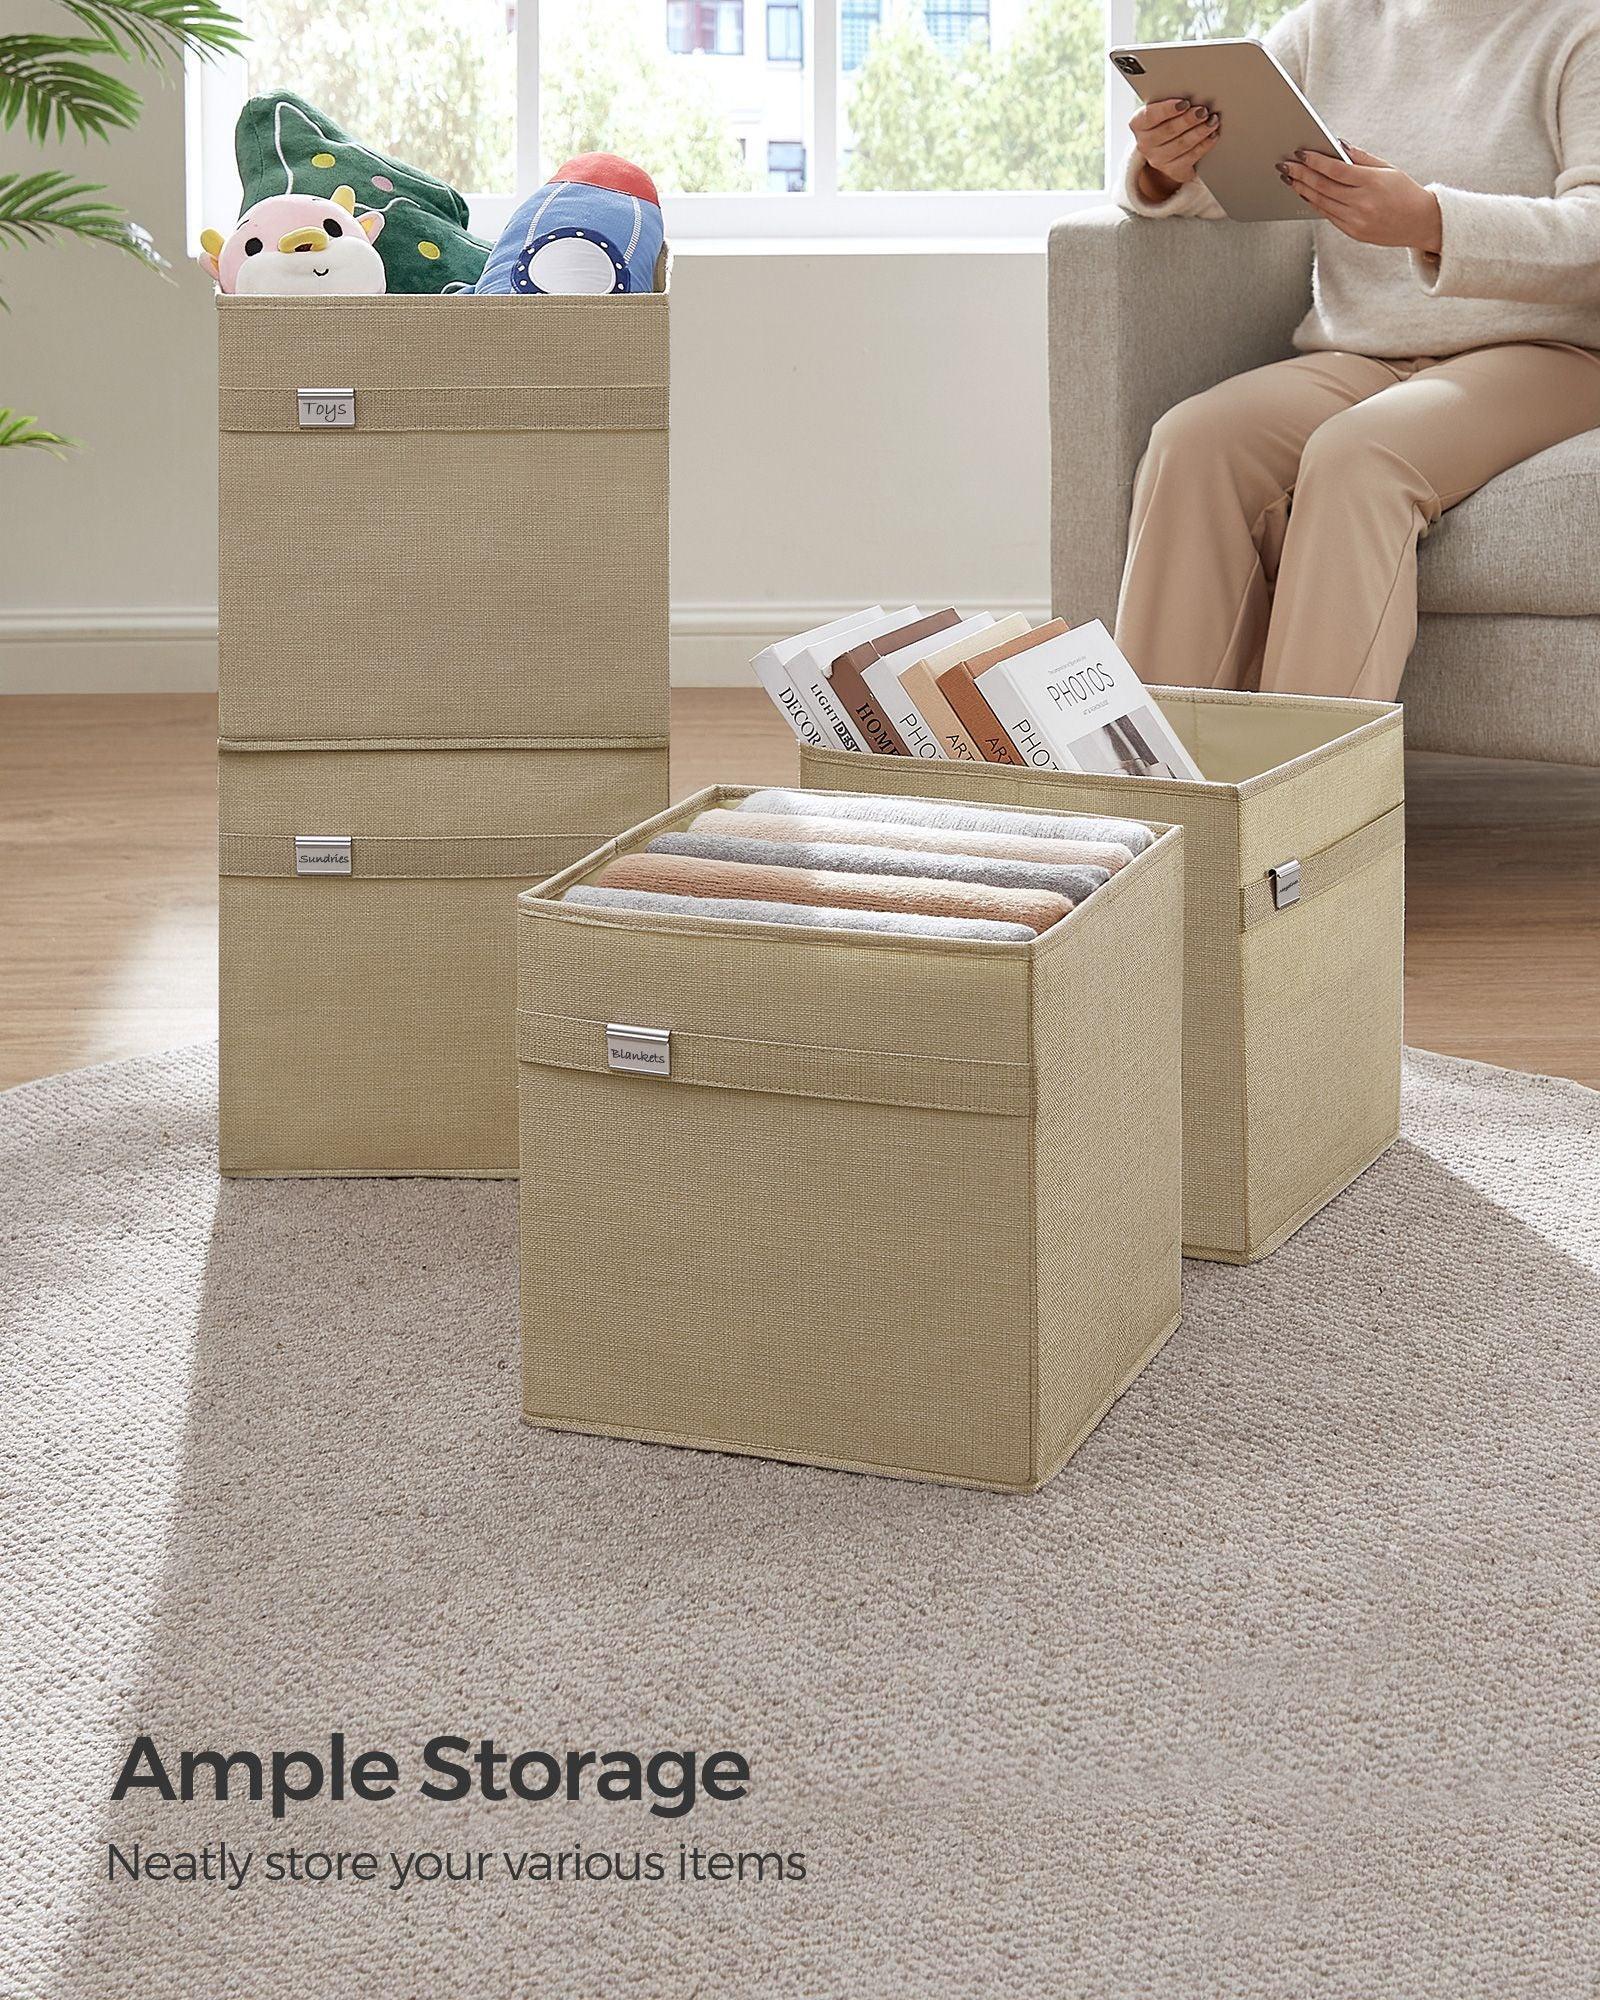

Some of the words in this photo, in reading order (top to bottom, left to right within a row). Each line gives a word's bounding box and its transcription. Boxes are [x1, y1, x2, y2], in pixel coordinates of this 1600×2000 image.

[302, 402, 347, 423] Toys
[1046, 662, 1115, 711] PHOTOS
[778, 686, 827, 748] DECOR
[810, 683, 840, 723] LIGHT
[899, 712, 942, 760] PHO
[946, 734, 976, 762] ART
[985, 738, 1016, 766] ART
[298, 853, 350, 864] Sundries
[610, 1048, 665, 1063] Blankets
